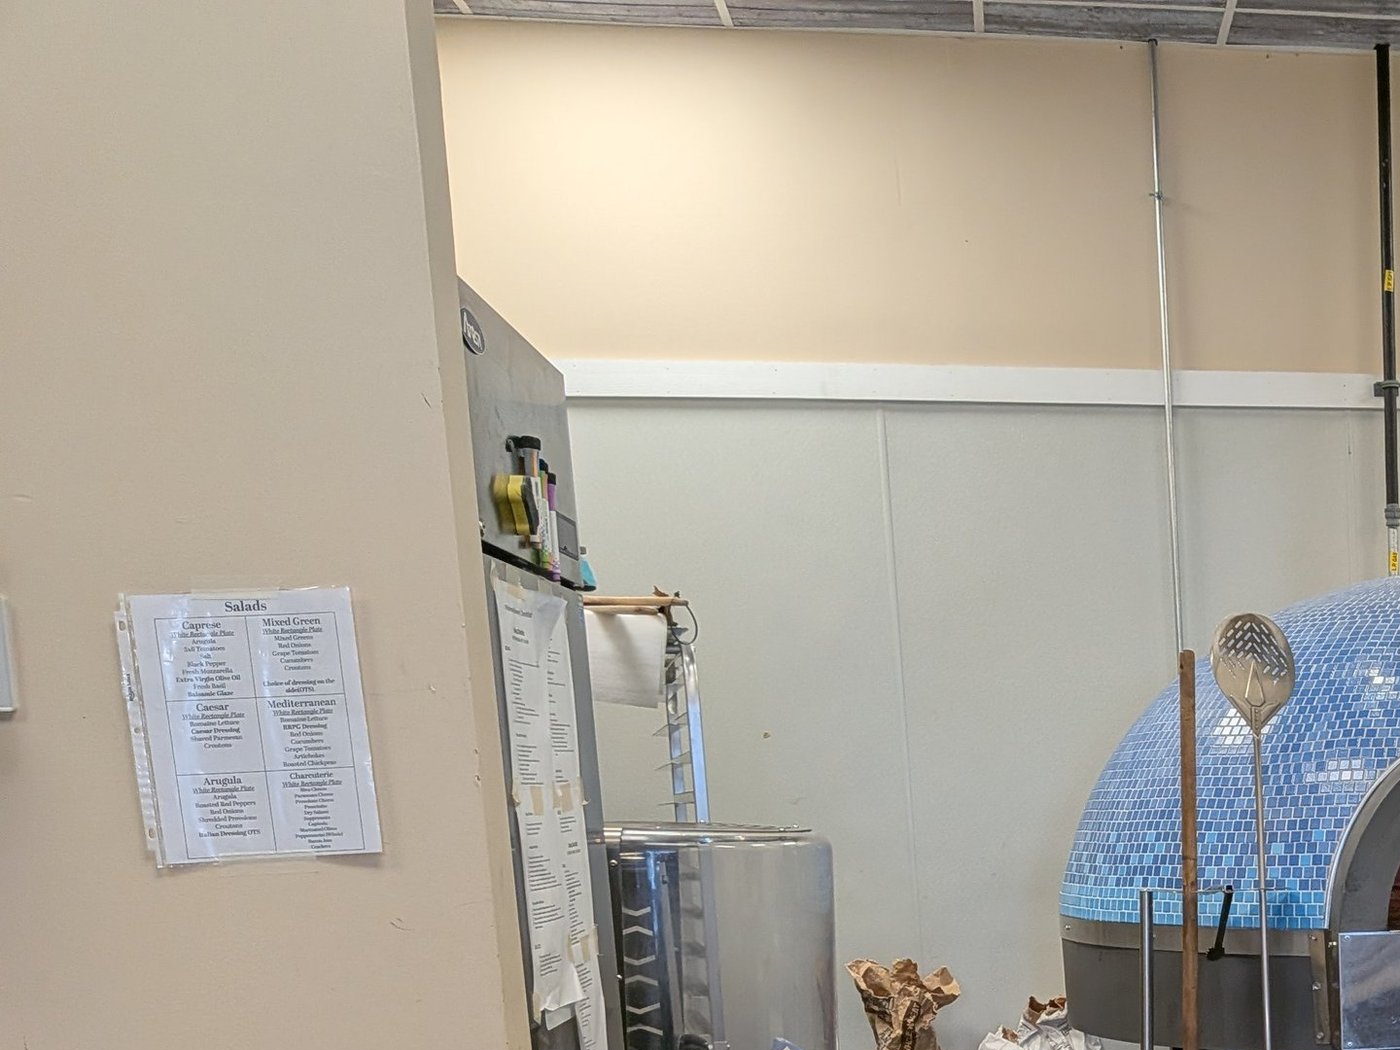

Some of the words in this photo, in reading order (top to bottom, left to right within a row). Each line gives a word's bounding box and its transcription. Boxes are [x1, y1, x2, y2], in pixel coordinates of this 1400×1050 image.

[225, 600, 267, 612] Salads
[182, 621, 221, 631] Caprese
[262, 617, 291, 627] Mixed
[292, 616, 321, 625] Green
[196, 703, 229, 712] Caesar
[268, 699, 336, 709] Mediterranean
[289, 772, 333, 780] Charcuterie
[204, 776, 242, 787] Arugula
